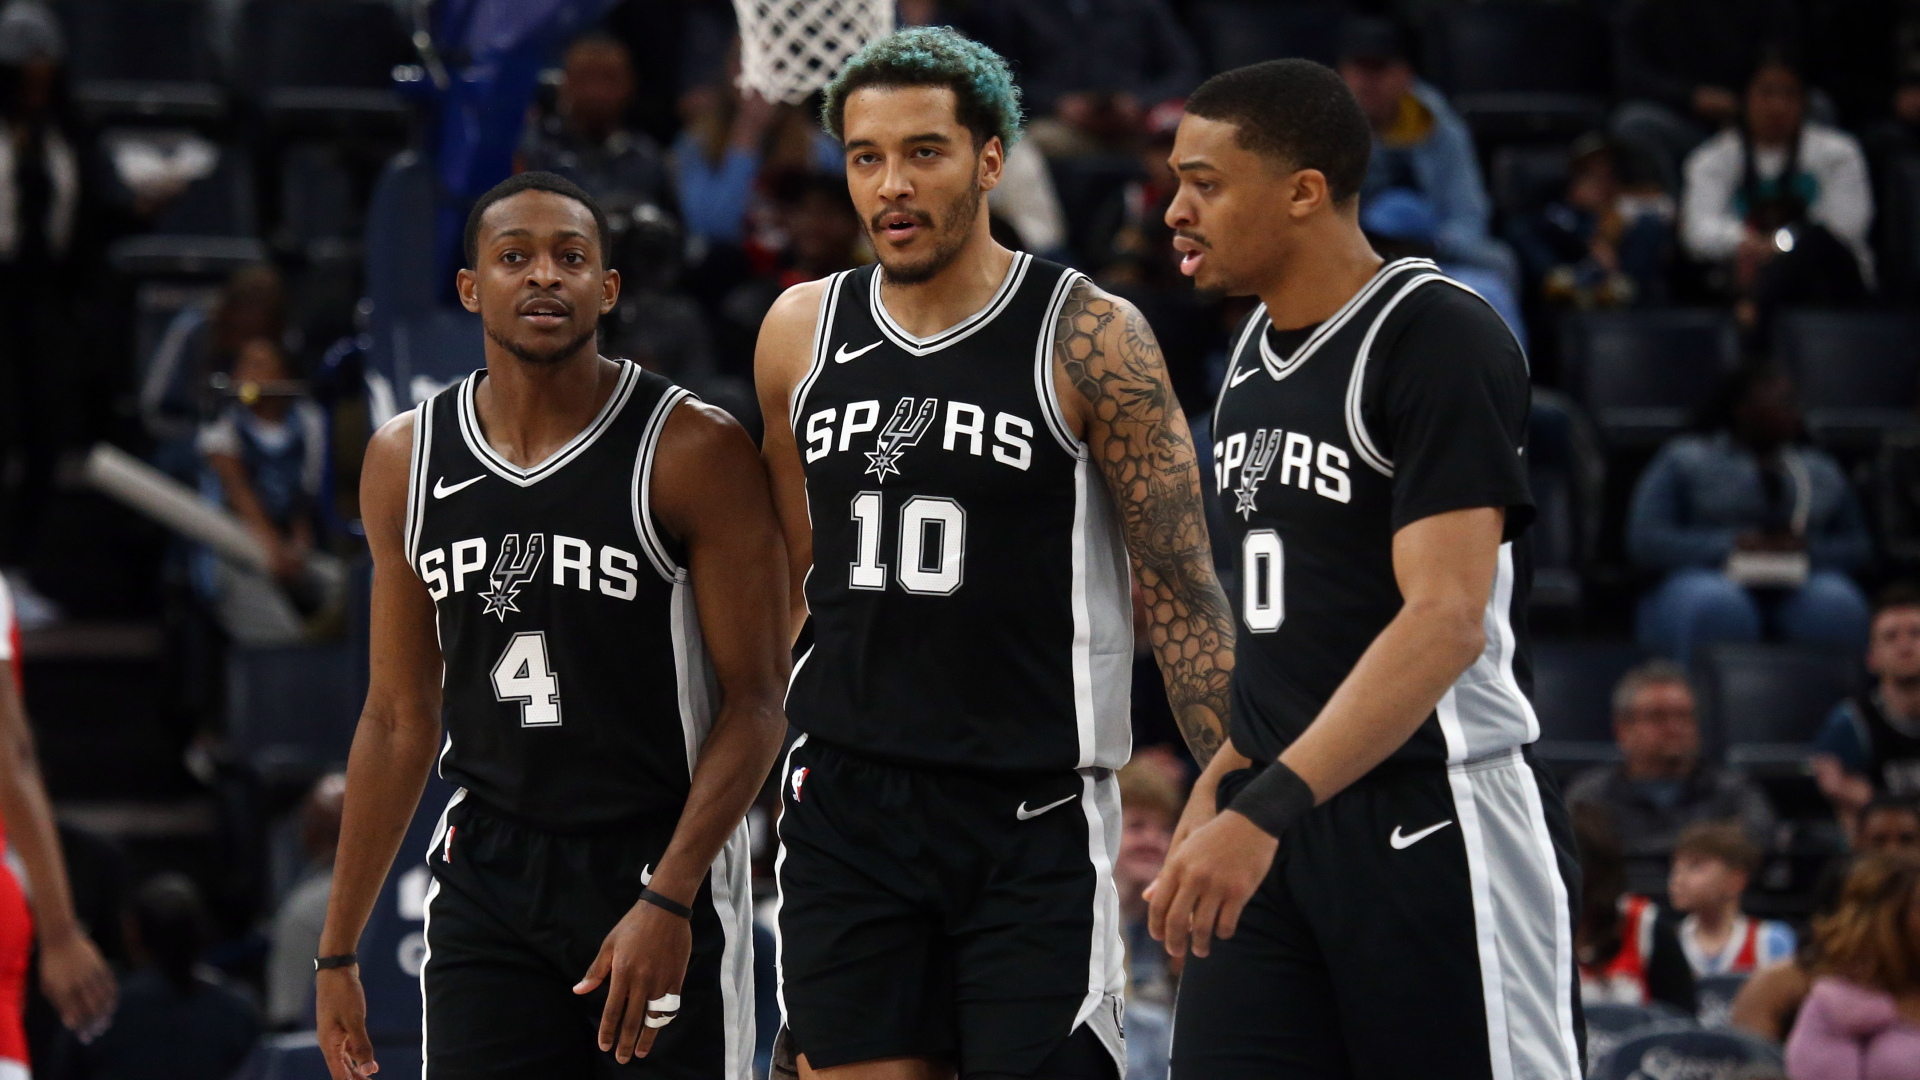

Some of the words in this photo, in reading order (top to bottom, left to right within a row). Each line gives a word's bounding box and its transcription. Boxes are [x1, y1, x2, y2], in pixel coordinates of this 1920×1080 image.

[805, 397, 1034, 485] SPURS
[1213, 428, 1352, 522] SPURS
[418, 532, 639, 623] SPURS
[848, 490, 967, 596] 10
[1241, 528, 1286, 634] 0
[489, 630, 563, 728] 4
